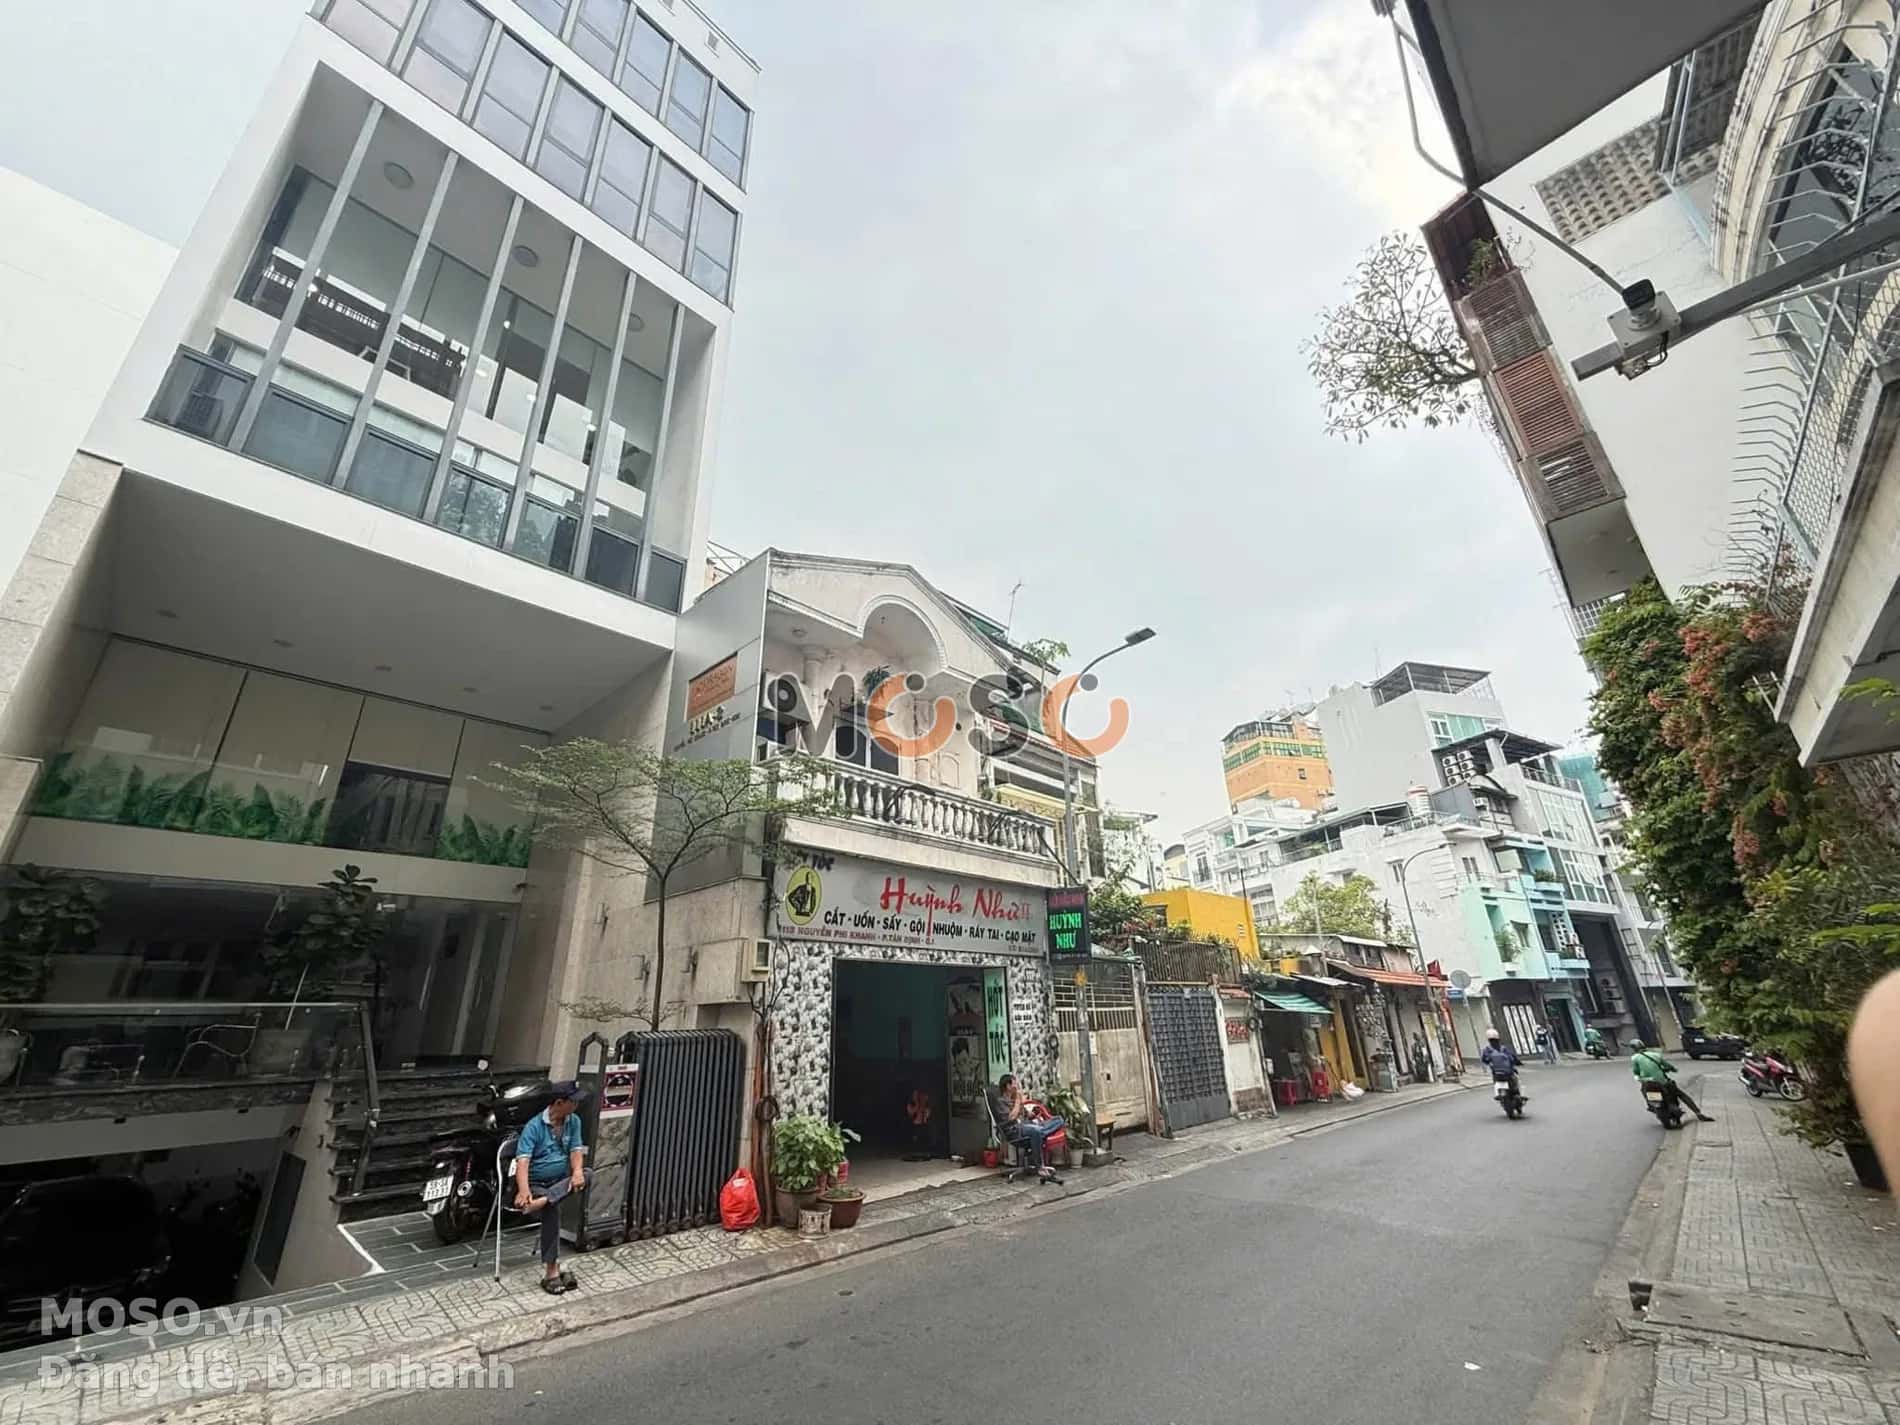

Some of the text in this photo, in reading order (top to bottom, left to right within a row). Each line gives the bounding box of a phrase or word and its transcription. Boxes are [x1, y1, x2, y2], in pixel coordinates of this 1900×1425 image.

[853, 909, 876, 929] UỐN
[882, 913, 902, 931] SẤY
[909, 918, 926, 936] GỘI
[932, 921, 963, 939] NHUỘM
[987, 928, 1000, 941] TAI
[879, 875, 964, 937] Huỳnh
